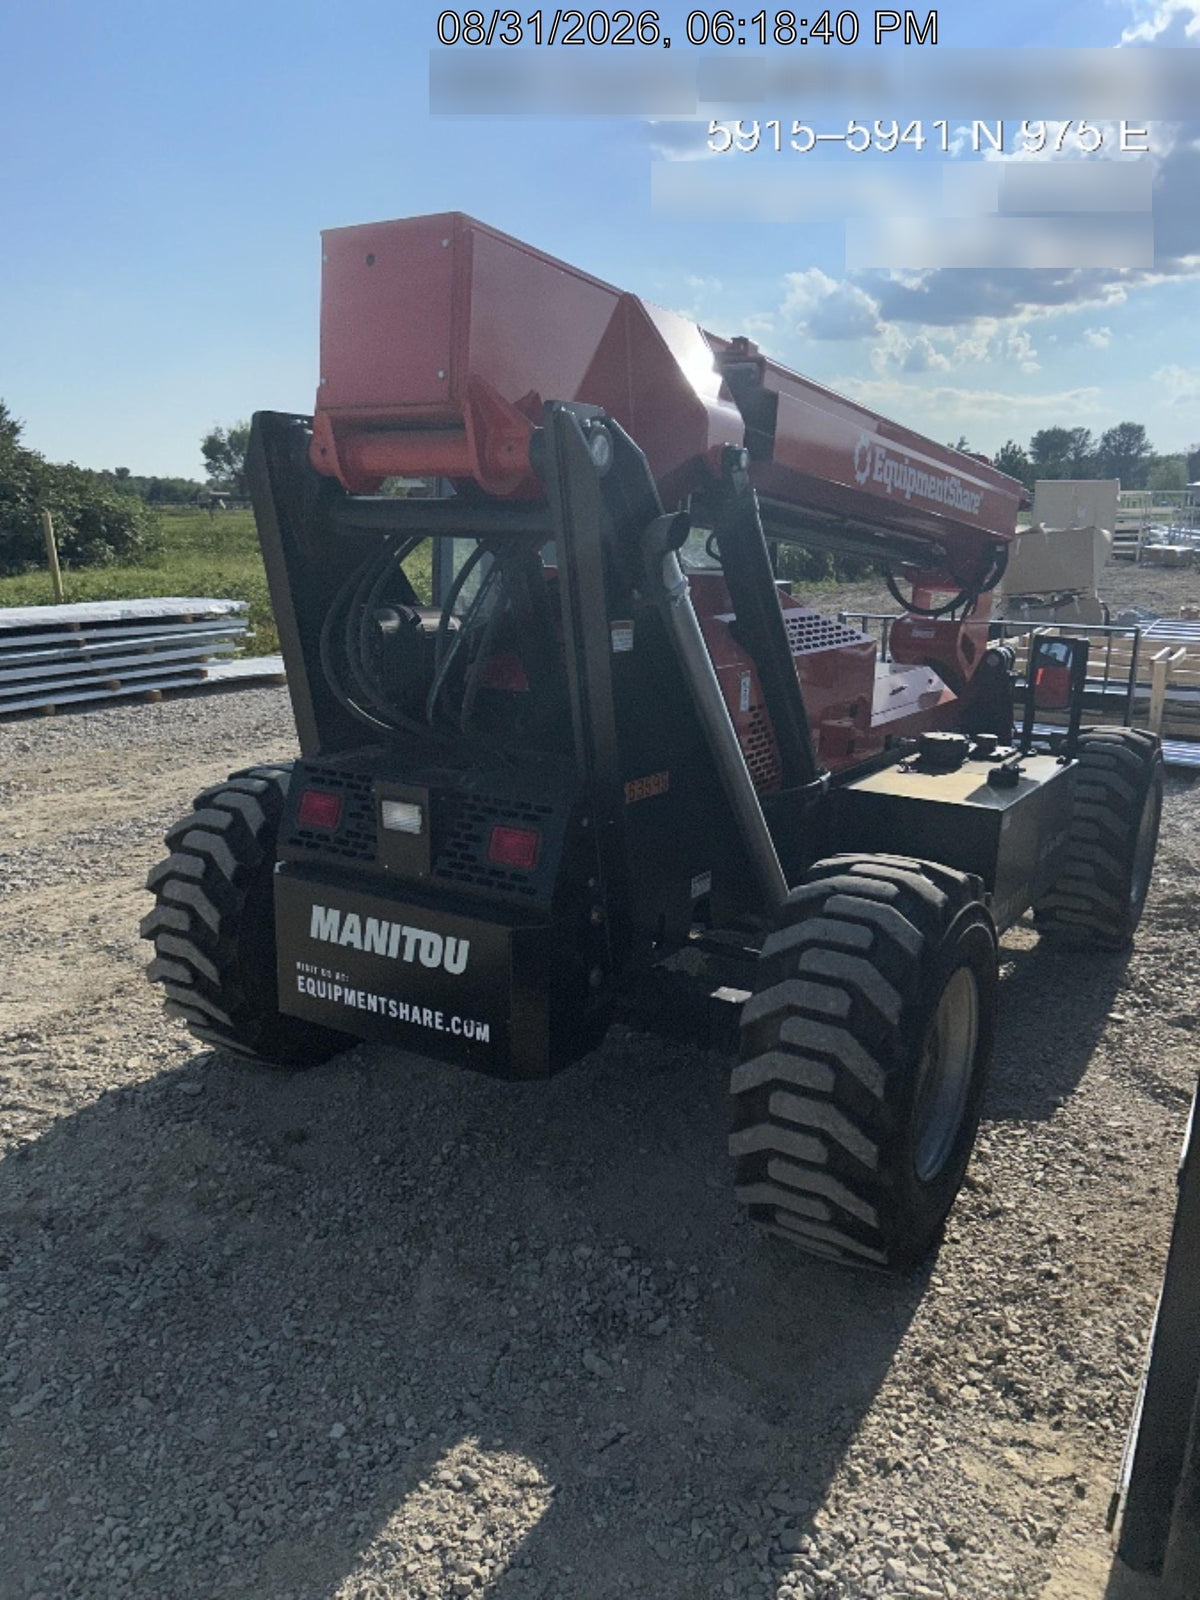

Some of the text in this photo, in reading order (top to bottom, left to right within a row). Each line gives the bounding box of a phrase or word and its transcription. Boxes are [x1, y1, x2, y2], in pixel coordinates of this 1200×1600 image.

[872, 446, 981, 515] EquipmentShare
[310, 904, 470, 976] MANITOU
[297, 975, 490, 1043] EQUIPMENTSHARE.COM
